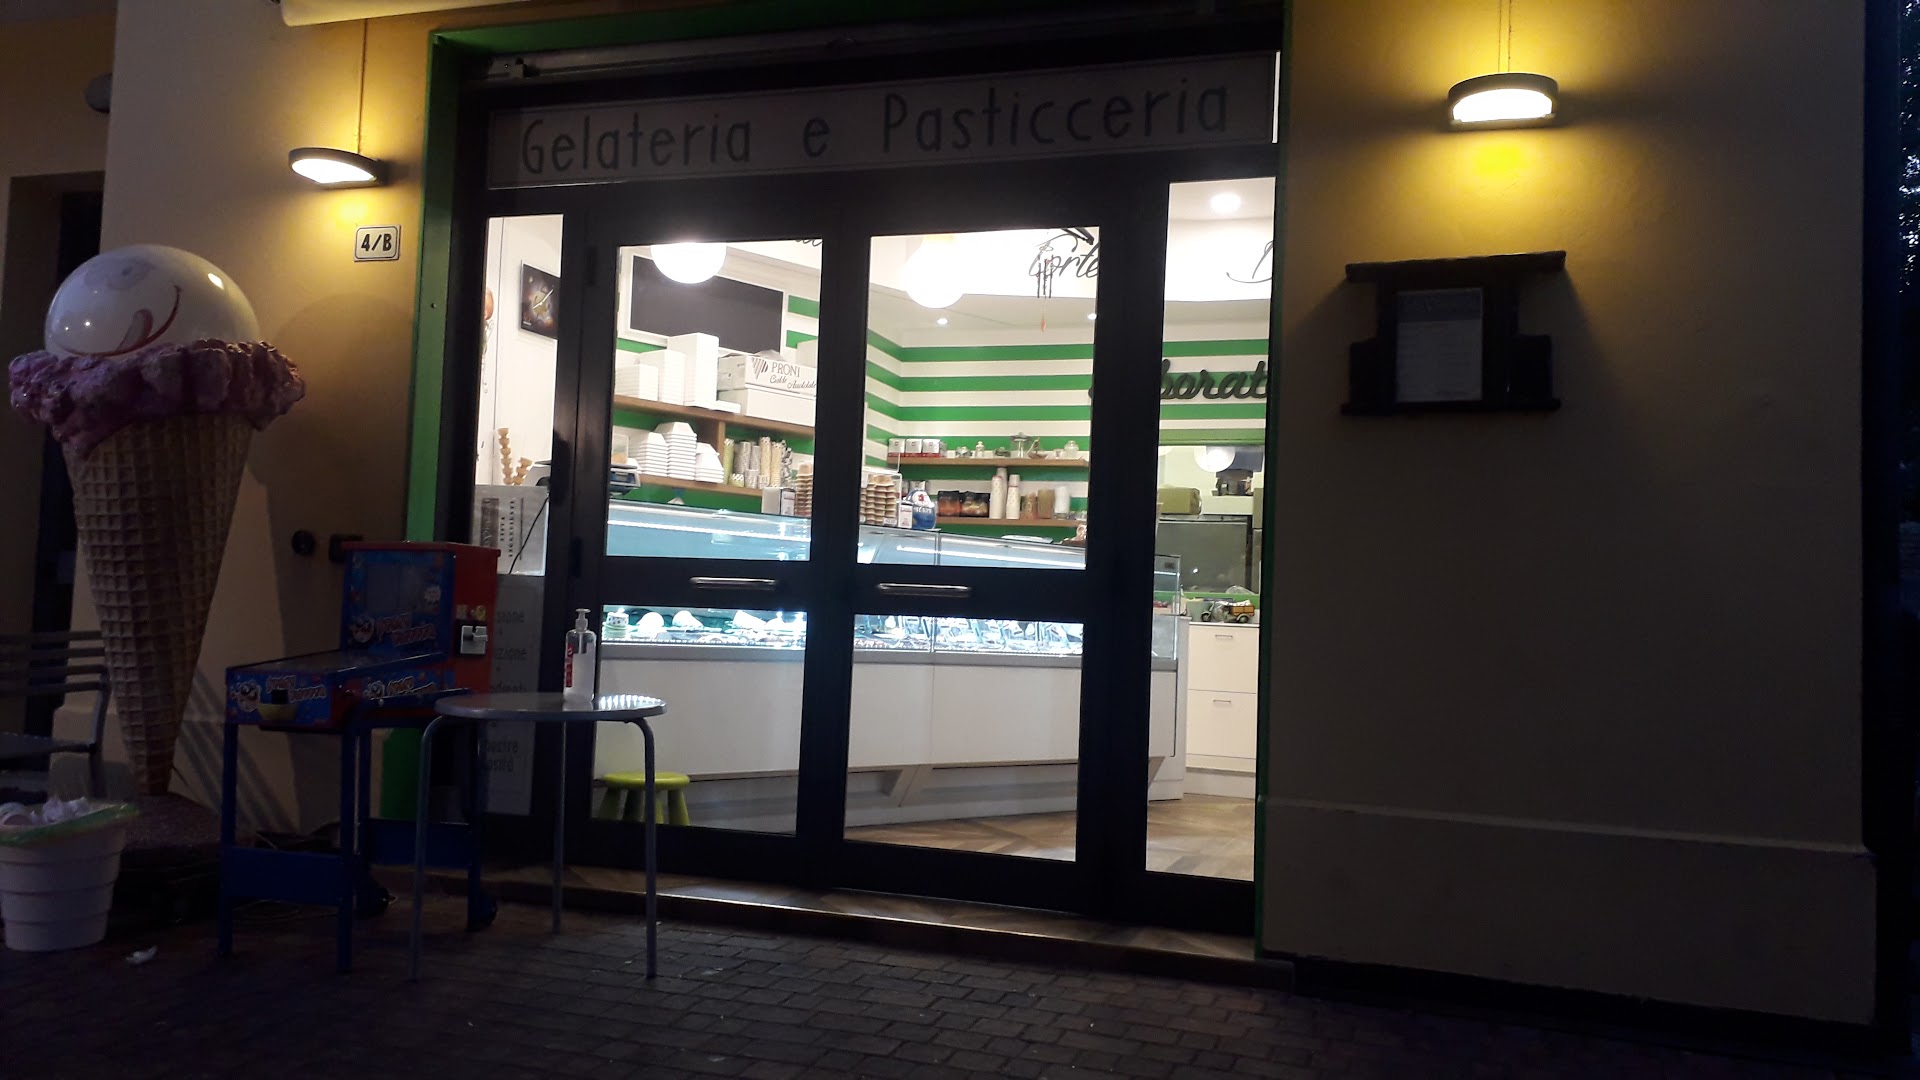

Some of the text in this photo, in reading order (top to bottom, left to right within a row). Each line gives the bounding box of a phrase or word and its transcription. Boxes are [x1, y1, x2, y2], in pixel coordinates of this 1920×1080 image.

[522, 78, 1228, 175] Gelateria e Pasticceria
[360, 233, 393, 252] 4/B
[771, 361, 801, 377] PRONI
